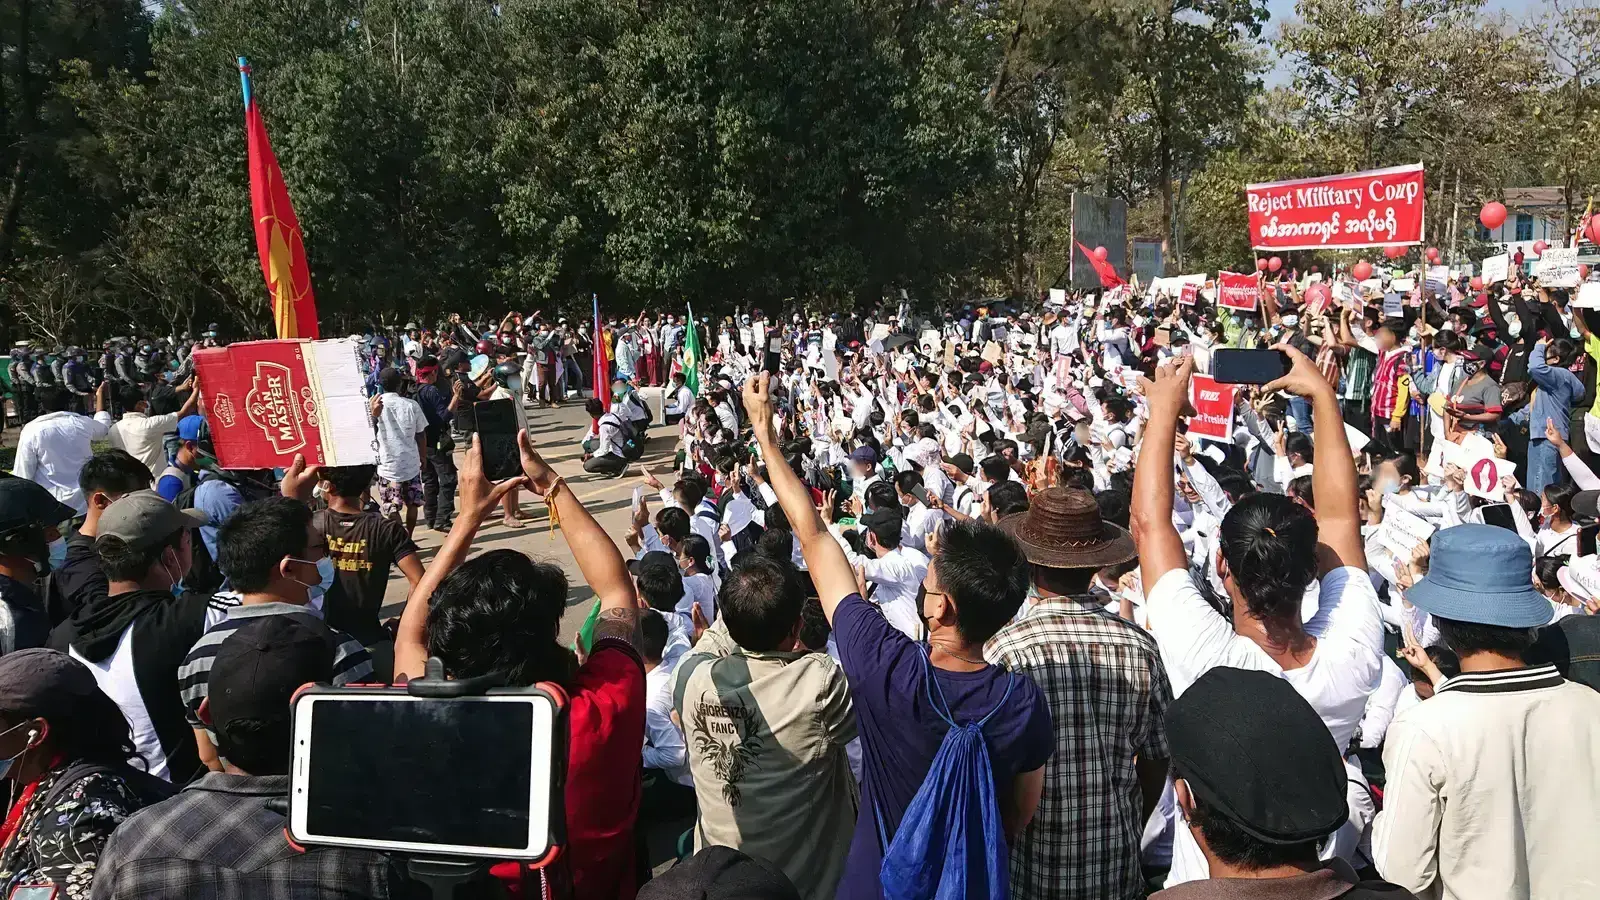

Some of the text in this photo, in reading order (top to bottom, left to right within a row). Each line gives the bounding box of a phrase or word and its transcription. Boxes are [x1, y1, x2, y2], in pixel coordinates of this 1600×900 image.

[1248, 180, 1418, 216] Reject Military Coup
[262, 391, 279, 428] GLAN
[268, 375, 294, 441] MASTER
[700, 703, 748, 720] GIORENZO
[711, 722, 739, 734] FANCY
